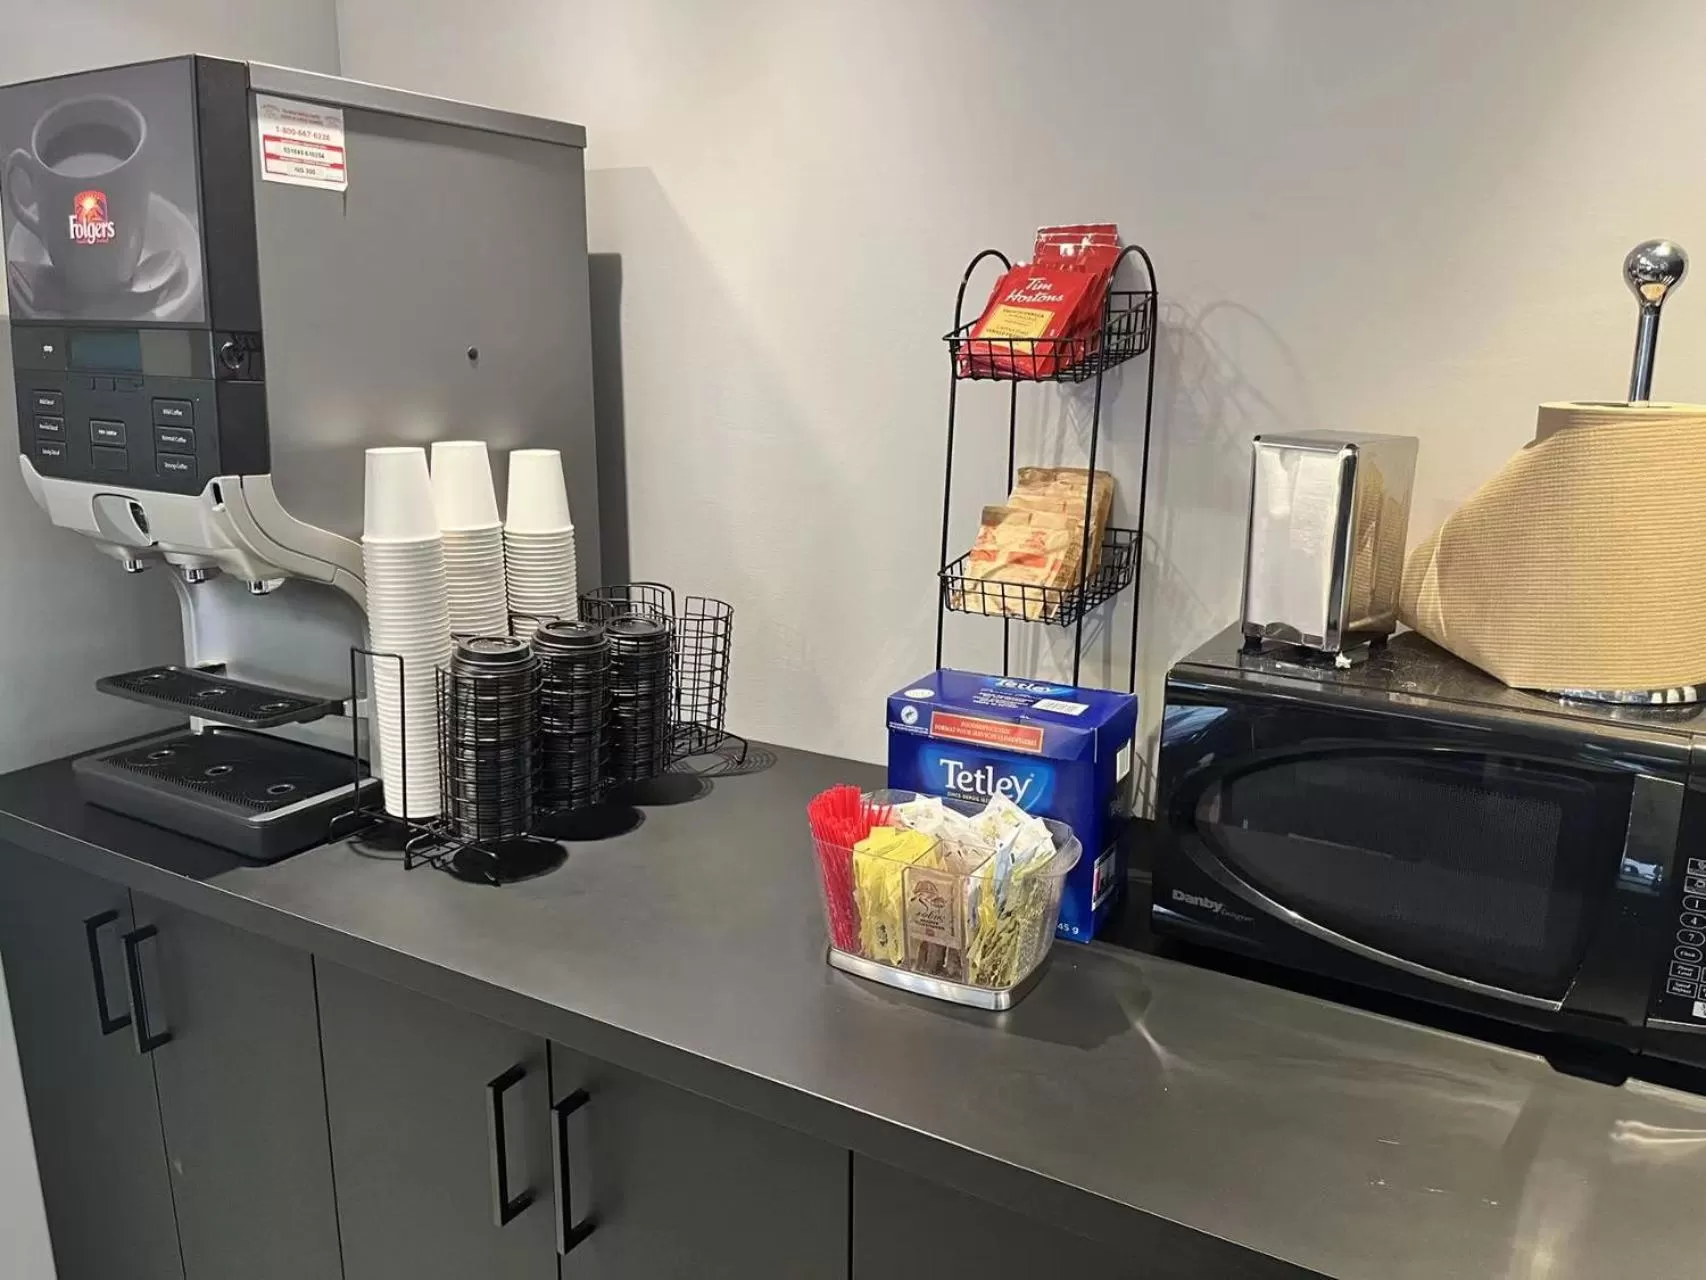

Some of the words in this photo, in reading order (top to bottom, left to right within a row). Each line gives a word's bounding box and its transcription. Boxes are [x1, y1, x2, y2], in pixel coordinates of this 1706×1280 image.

[68, 214, 116, 244] Folgers
[1026, 277, 1053, 291] Tim
[1005, 288, 1065, 303] Hortons
[940, 758, 1033, 805] Tetley
[1172, 889, 1223, 913] Danby
[1688, 933, 1695, 941] 7
